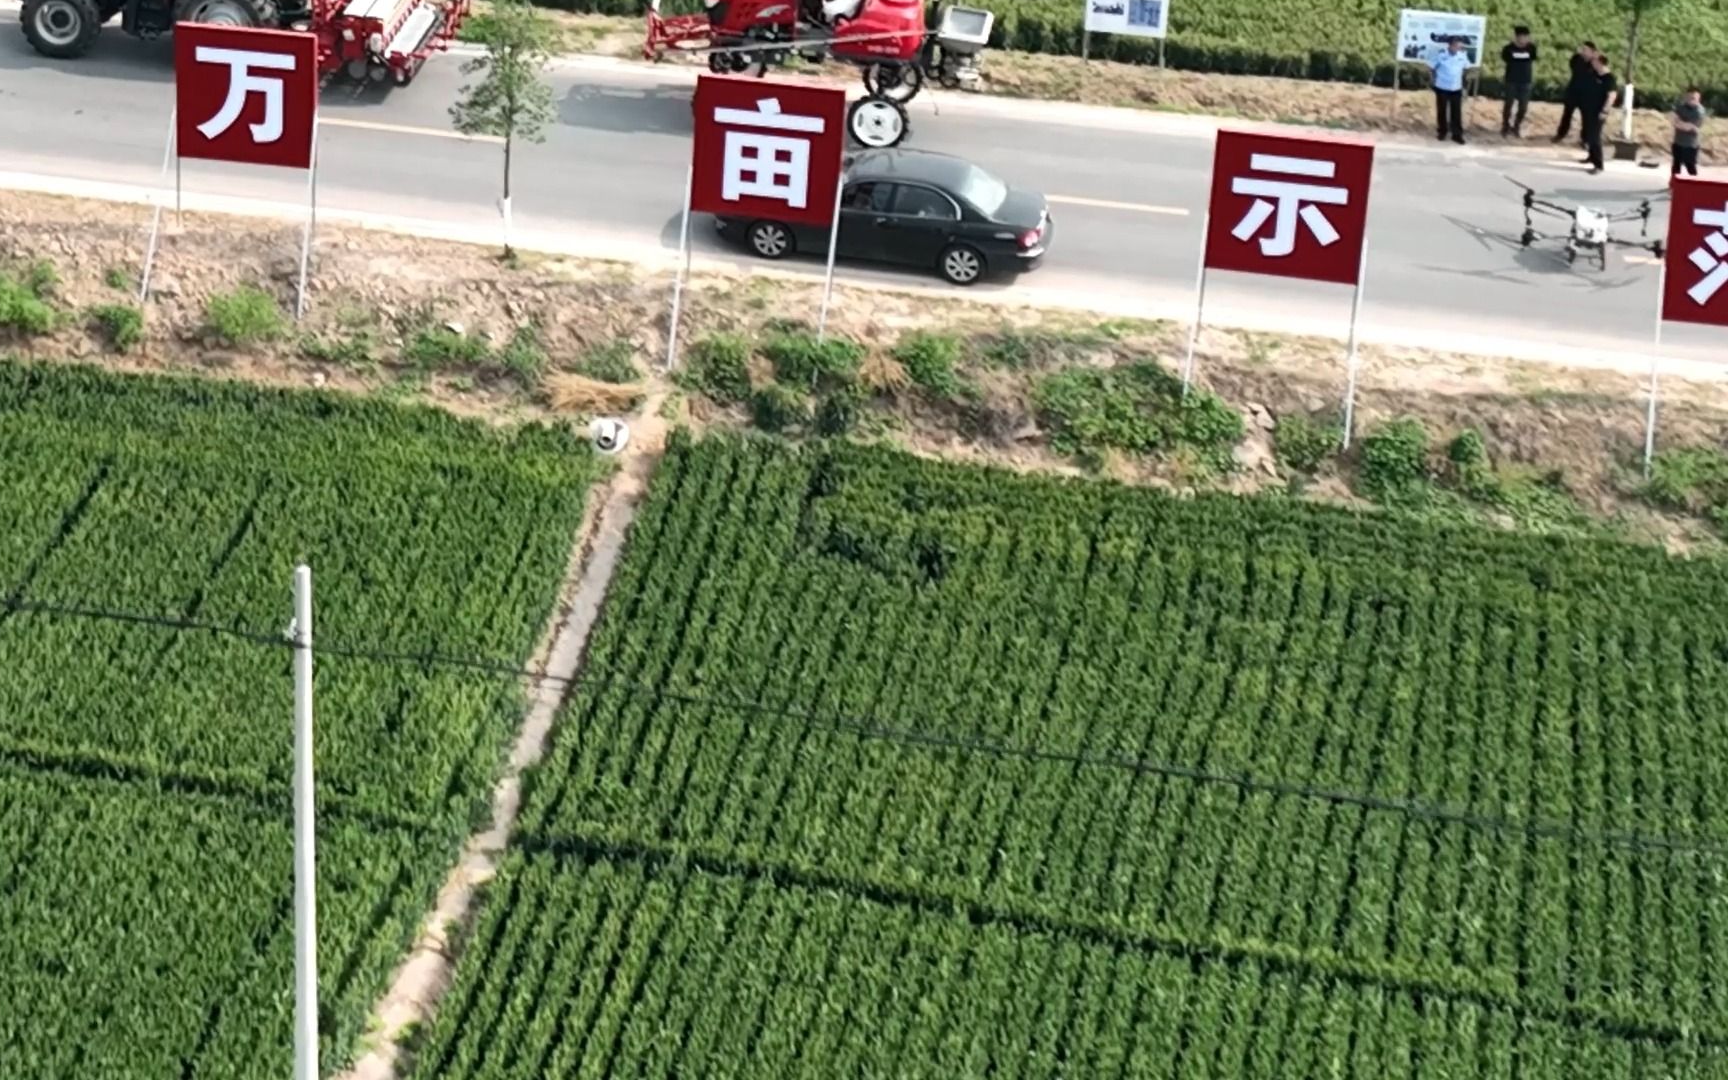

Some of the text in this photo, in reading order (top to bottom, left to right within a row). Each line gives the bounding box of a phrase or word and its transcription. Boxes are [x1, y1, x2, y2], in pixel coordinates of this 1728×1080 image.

[195, 46, 296, 143] 万
[714, 98, 825, 209] 亩
[1231, 153, 1349, 256] 示
